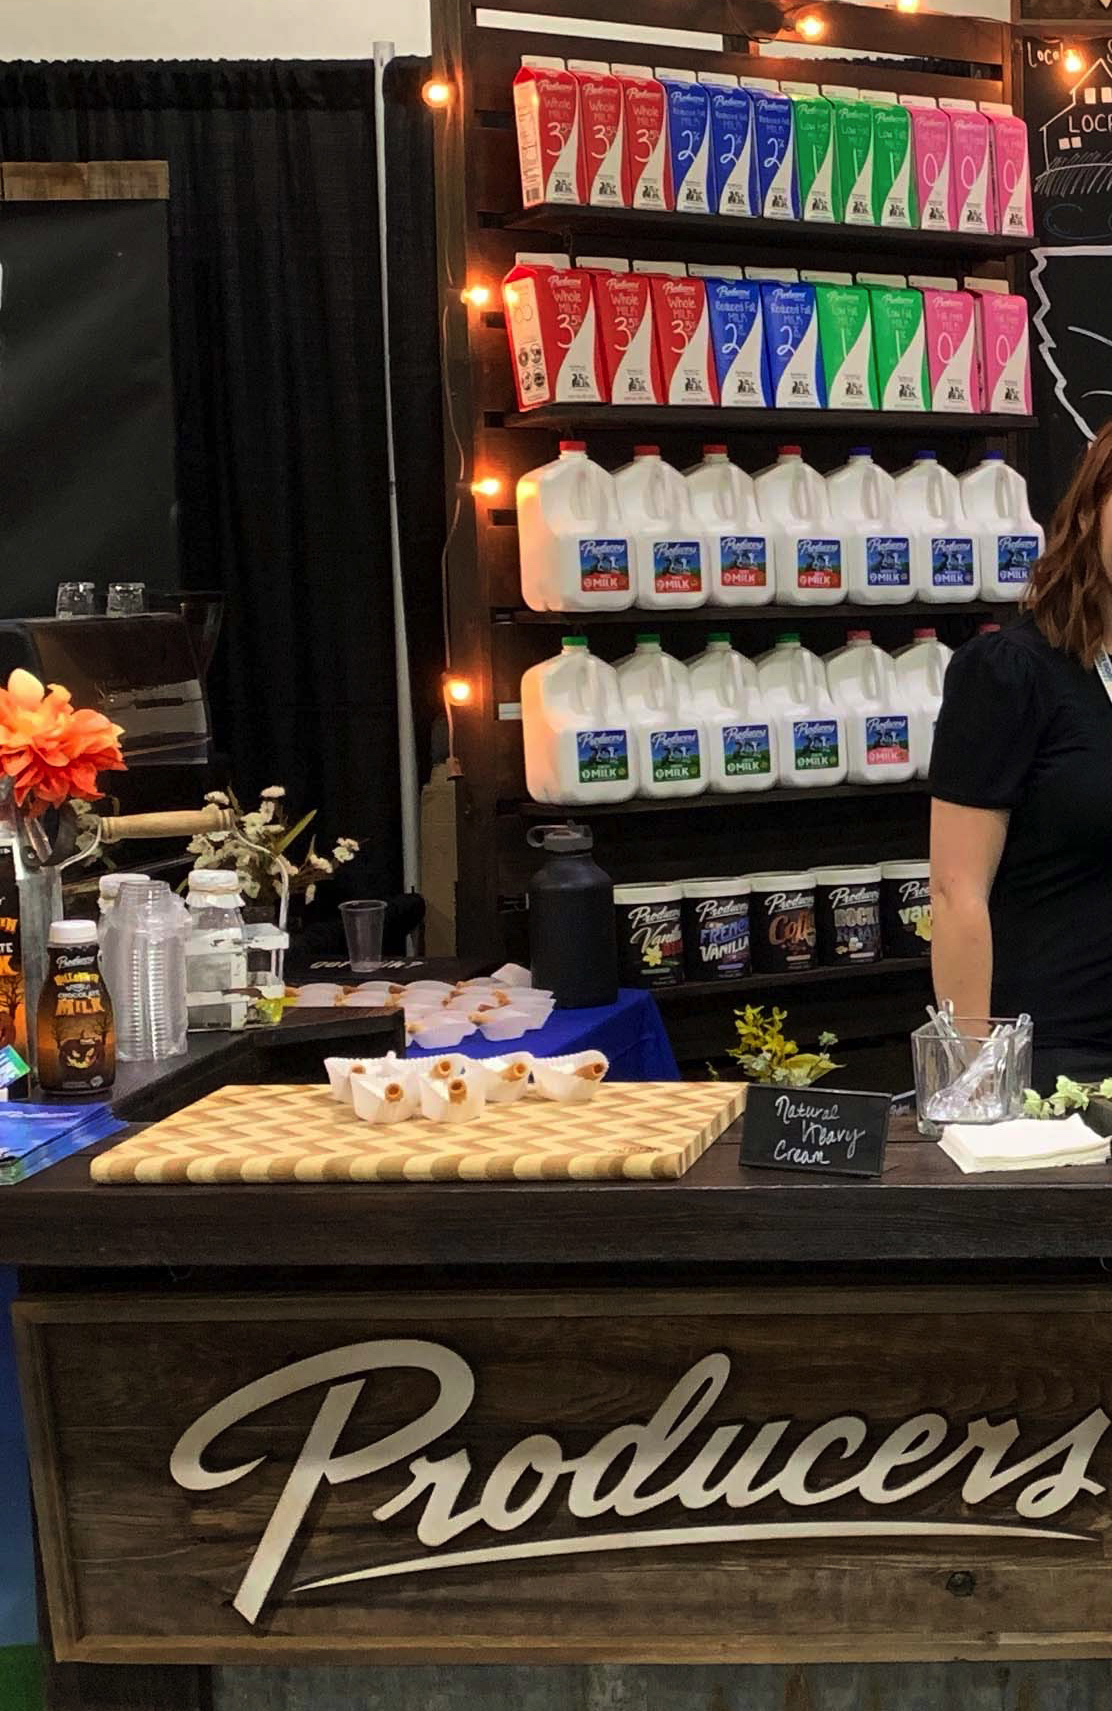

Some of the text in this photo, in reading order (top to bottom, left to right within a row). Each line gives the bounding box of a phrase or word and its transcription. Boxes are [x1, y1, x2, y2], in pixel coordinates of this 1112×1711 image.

[732, 573, 756, 584] MILK
[878, 572, 900, 583] MILK
[941, 573, 963, 584] MILK
[1007, 571, 1028, 580] MILK
[592, 577, 618, 589] MILK
[664, 579, 690, 590] MILK
[807, 576, 831, 587] MILK
[804, 756, 828, 766] MILK
[876, 751, 898, 761] MILK
[664, 766, 689, 777] MILK
[735, 761, 759, 771] MILK
[590, 767, 617, 778] MILK
[56, 998, 105, 1016] MILK
[775, 1095, 839, 1121] Natural
[773, 1140, 831, 1165] Cream
[168, 1339, 1112, 1625] Producers
